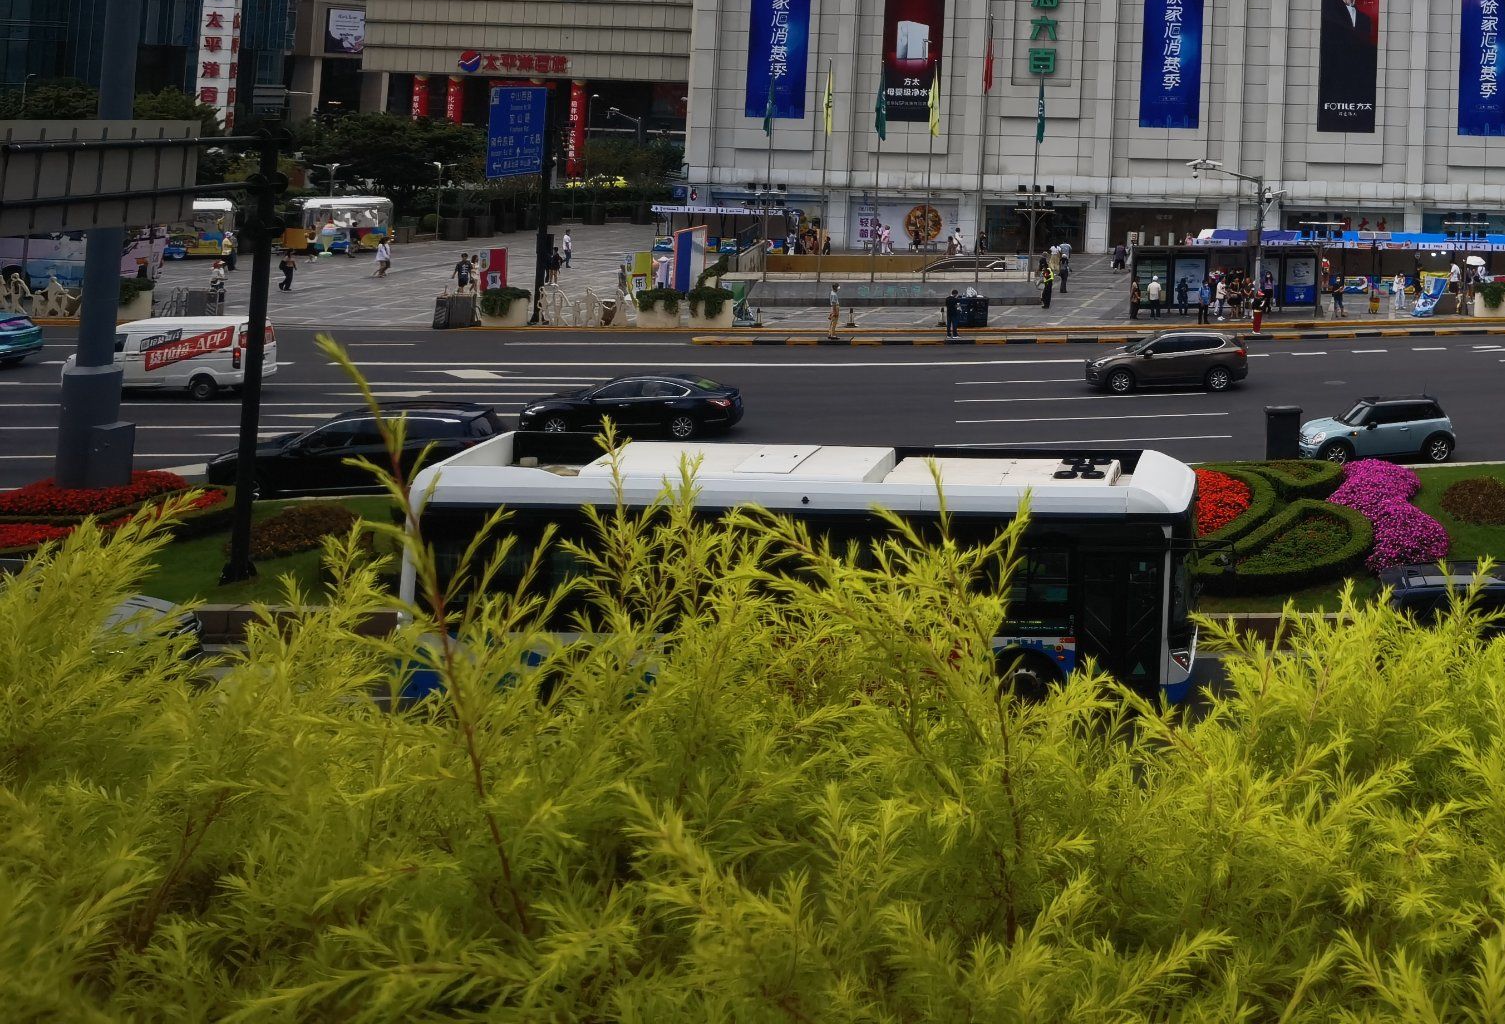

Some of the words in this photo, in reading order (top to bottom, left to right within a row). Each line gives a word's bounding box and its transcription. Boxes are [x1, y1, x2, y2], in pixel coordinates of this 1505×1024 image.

[200, 10, 223, 104] 太平洋百
[482, 54, 569, 74] 太平洋百货
[903, 77, 920, 86] 方太
[887, 87, 932, 97] 母婴级净水
[1324, 102, 1356, 111] FOTILE
[1356, 102, 1373, 111] 方太
[196, 330, 228, 351] APP
